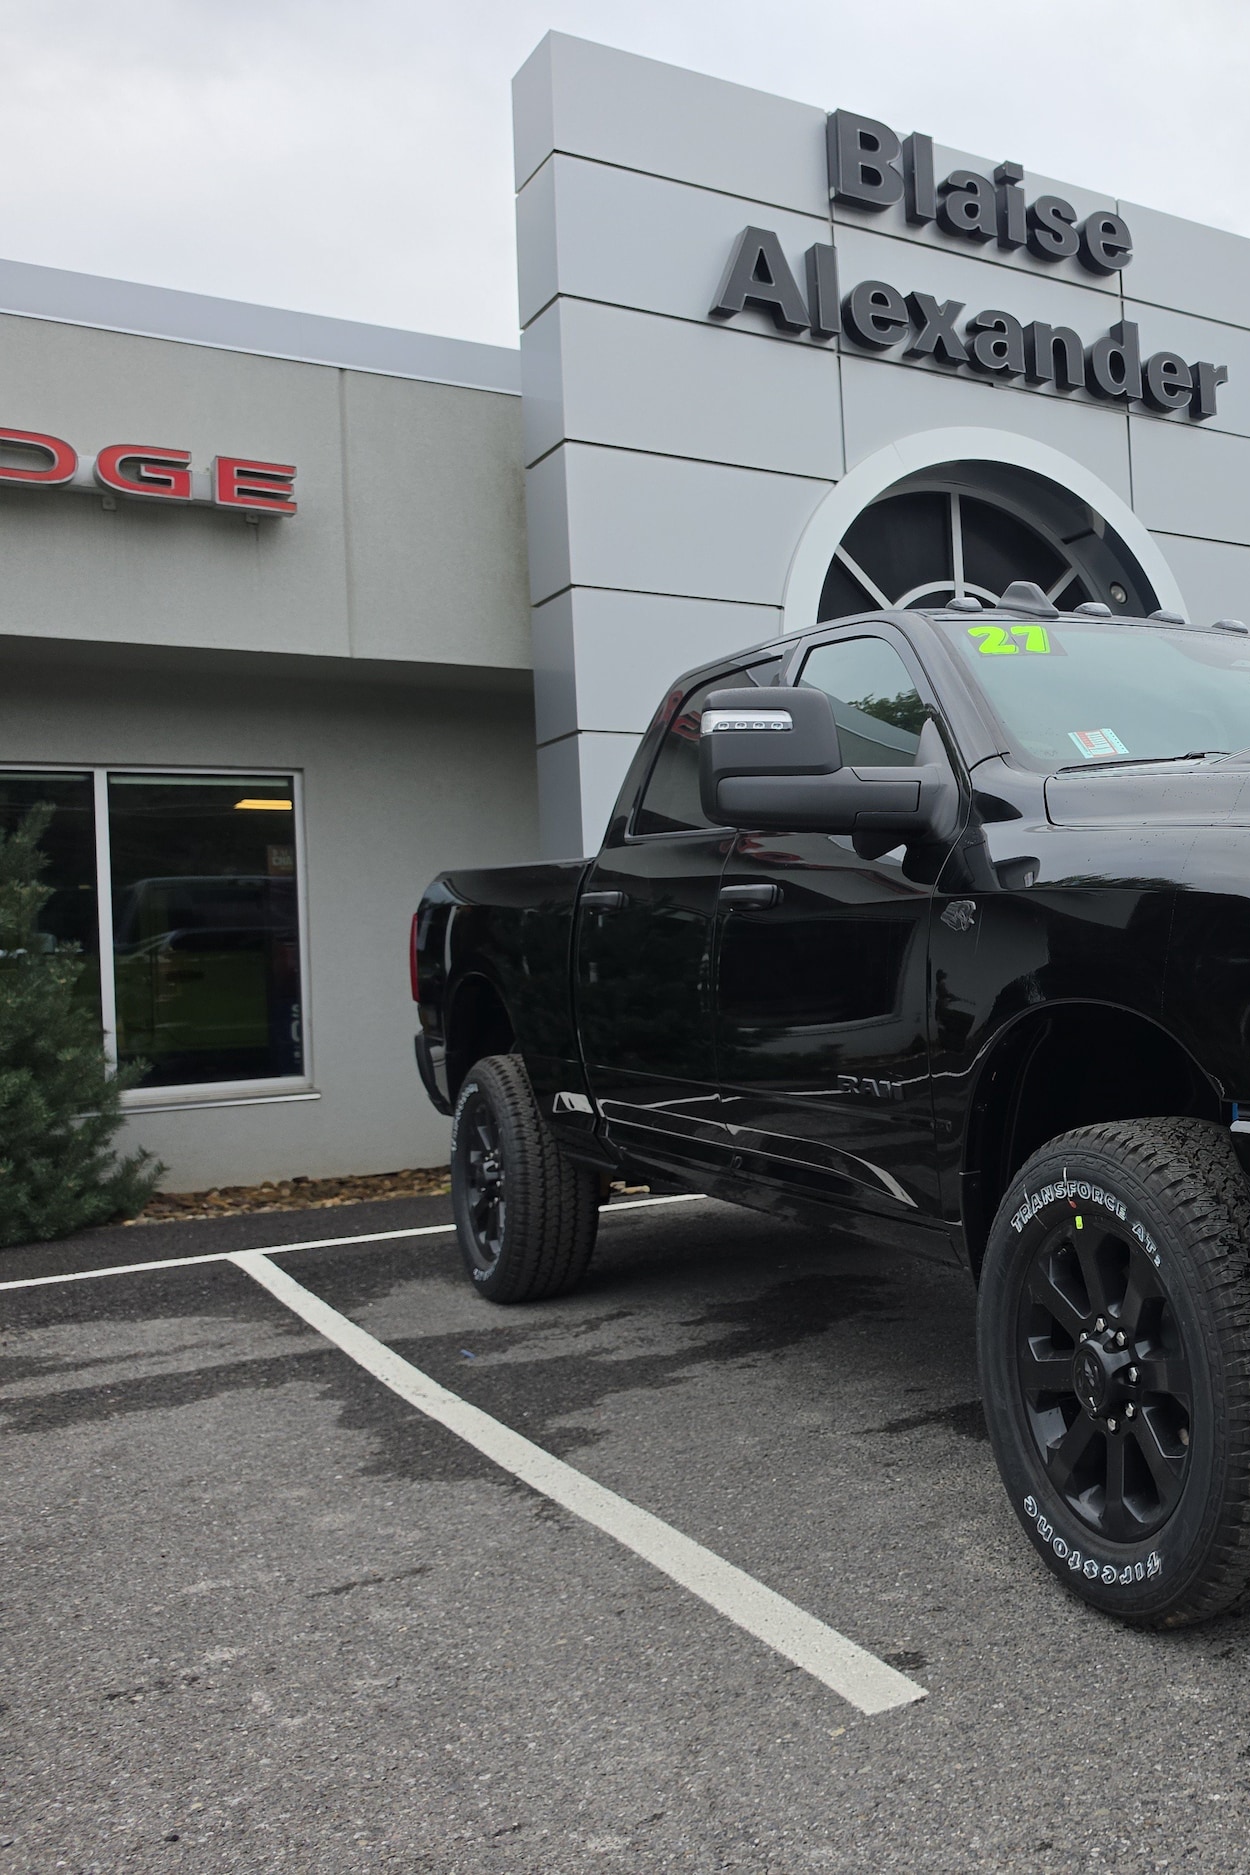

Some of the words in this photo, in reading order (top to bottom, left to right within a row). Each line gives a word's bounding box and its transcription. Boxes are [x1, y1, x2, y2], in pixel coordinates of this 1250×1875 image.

[826, 108, 1133, 276] Blaise
[708, 225, 1229, 421] Alexander
[967, 624, 1051, 654] 27
[1010, 1180, 1128, 1233] TRANSFORCE
